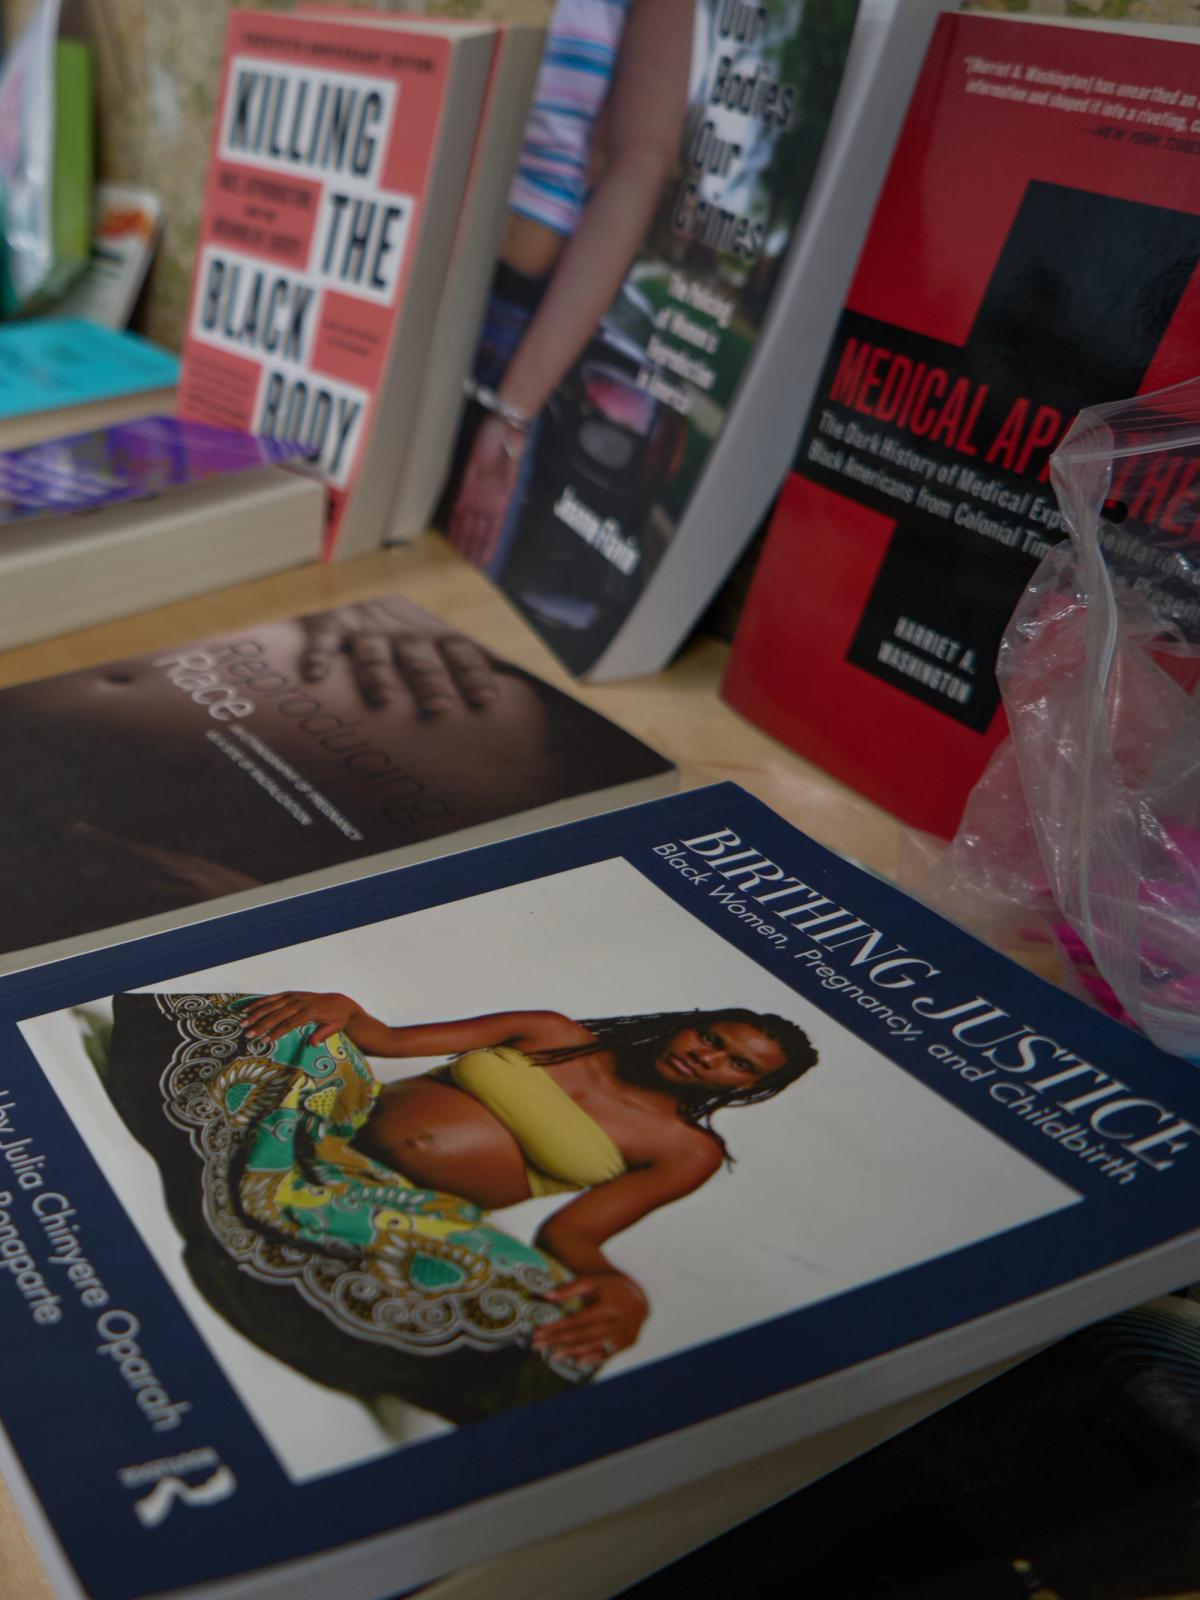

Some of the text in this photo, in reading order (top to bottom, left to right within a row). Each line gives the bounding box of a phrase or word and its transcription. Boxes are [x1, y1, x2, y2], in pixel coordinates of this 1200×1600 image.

[229, 70, 382, 178] KILLING
[689, 121, 741, 178] Our
[321, 193, 403, 290] THE
[202, 257, 315, 362] BLACK
[261, 371, 363, 476] BODY
[830, 335, 990, 457] MEDICAL
[807, 436, 844, 472] Black
[841, 454, 916, 504] Americans
[914, 485, 953, 520] from
[952, 501, 1021, 548] Colonial
[818, 410, 846, 436] The
[842, 420, 882, 456] Dark
[877, 432, 938, 482] History
[935, 463, 959, 486] of
[954, 466, 1031, 517] Medical
[877, 639, 974, 705] WASHINGTON
[893, 615, 963, 664] HARRIET
[214, 640, 452, 830] Reproducing
[679, 827, 940, 992] BIRTHING
[652, 841, 1139, 1185] Black Women, Pregnancy, and Childbirth
[912, 995, 1200, 1173] JUSTICE
[31, 1189, 110, 1308] Chinyere
[96, 1309, 192, 1432] Oparah
